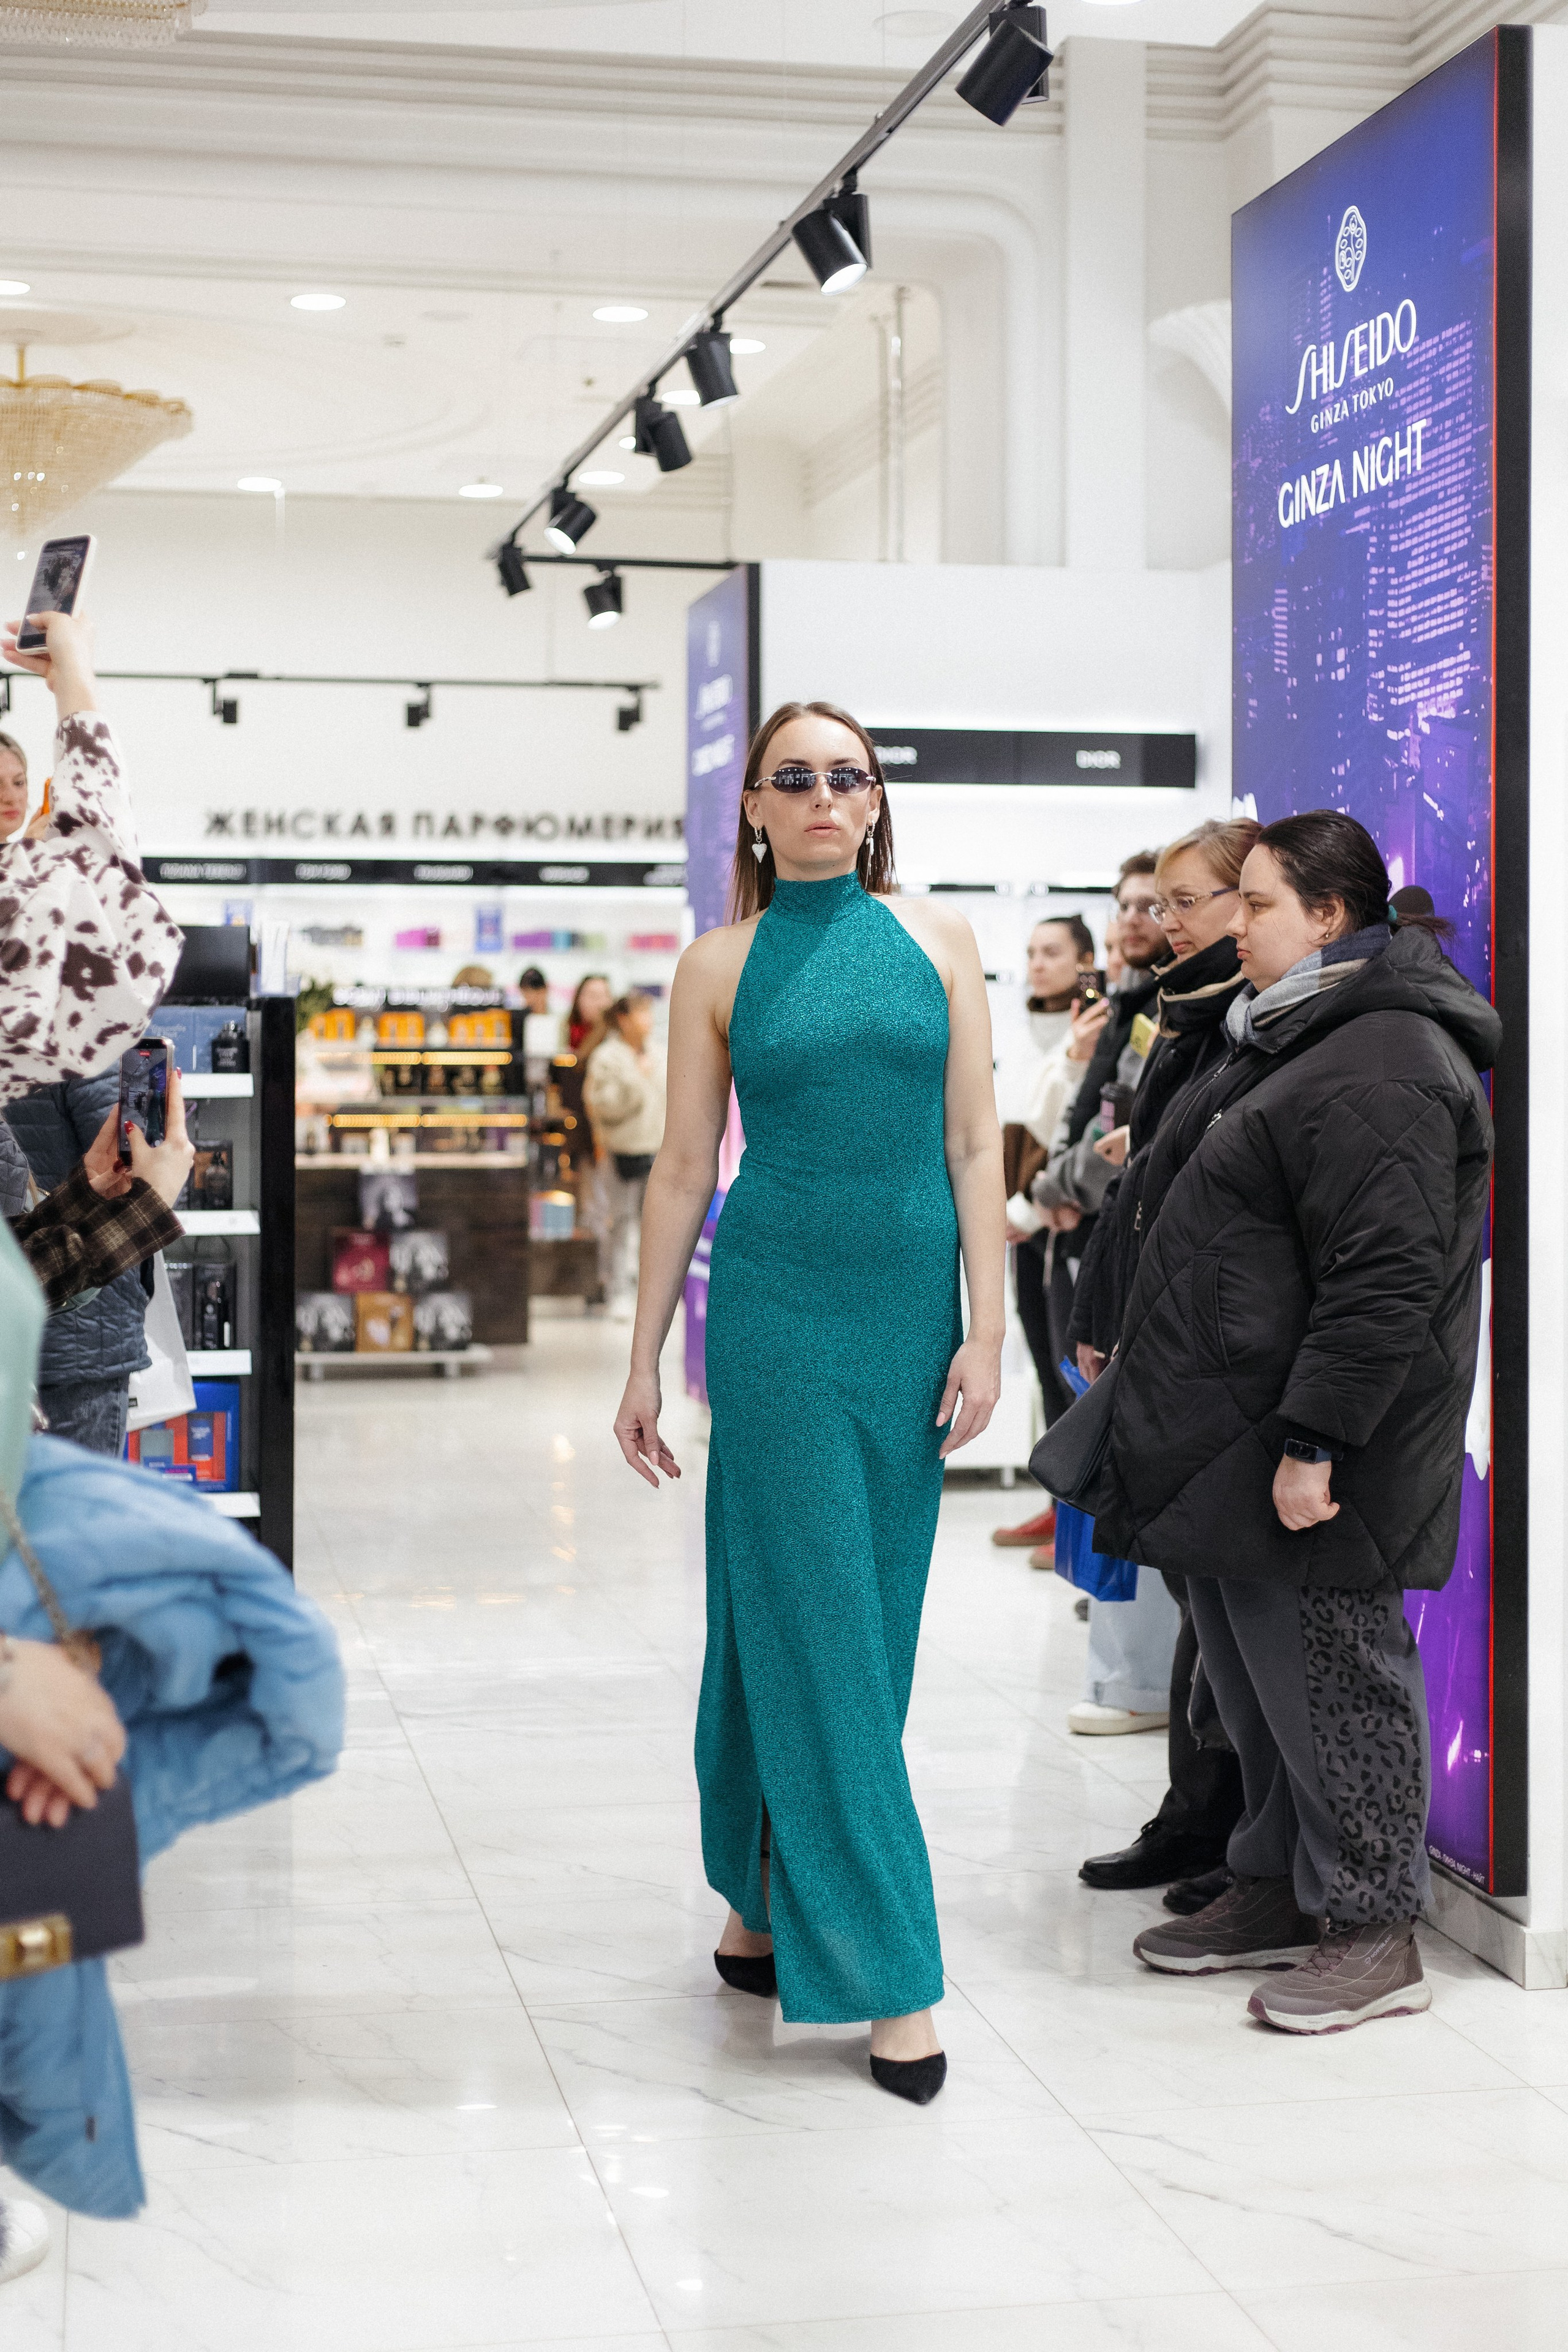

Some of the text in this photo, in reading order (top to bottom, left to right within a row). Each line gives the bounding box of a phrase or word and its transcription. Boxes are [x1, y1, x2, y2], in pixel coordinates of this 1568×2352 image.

[1285, 298, 1417, 415] SHISEIDO
[1311, 377, 1394, 433] GINZA TOKYO
[1278, 418, 1427, 528] GINZA NIGHT
[205, 810, 396, 839] ЖЕНСКАЯ
[1371, 1934, 1393, 1958] NORTHLAND
